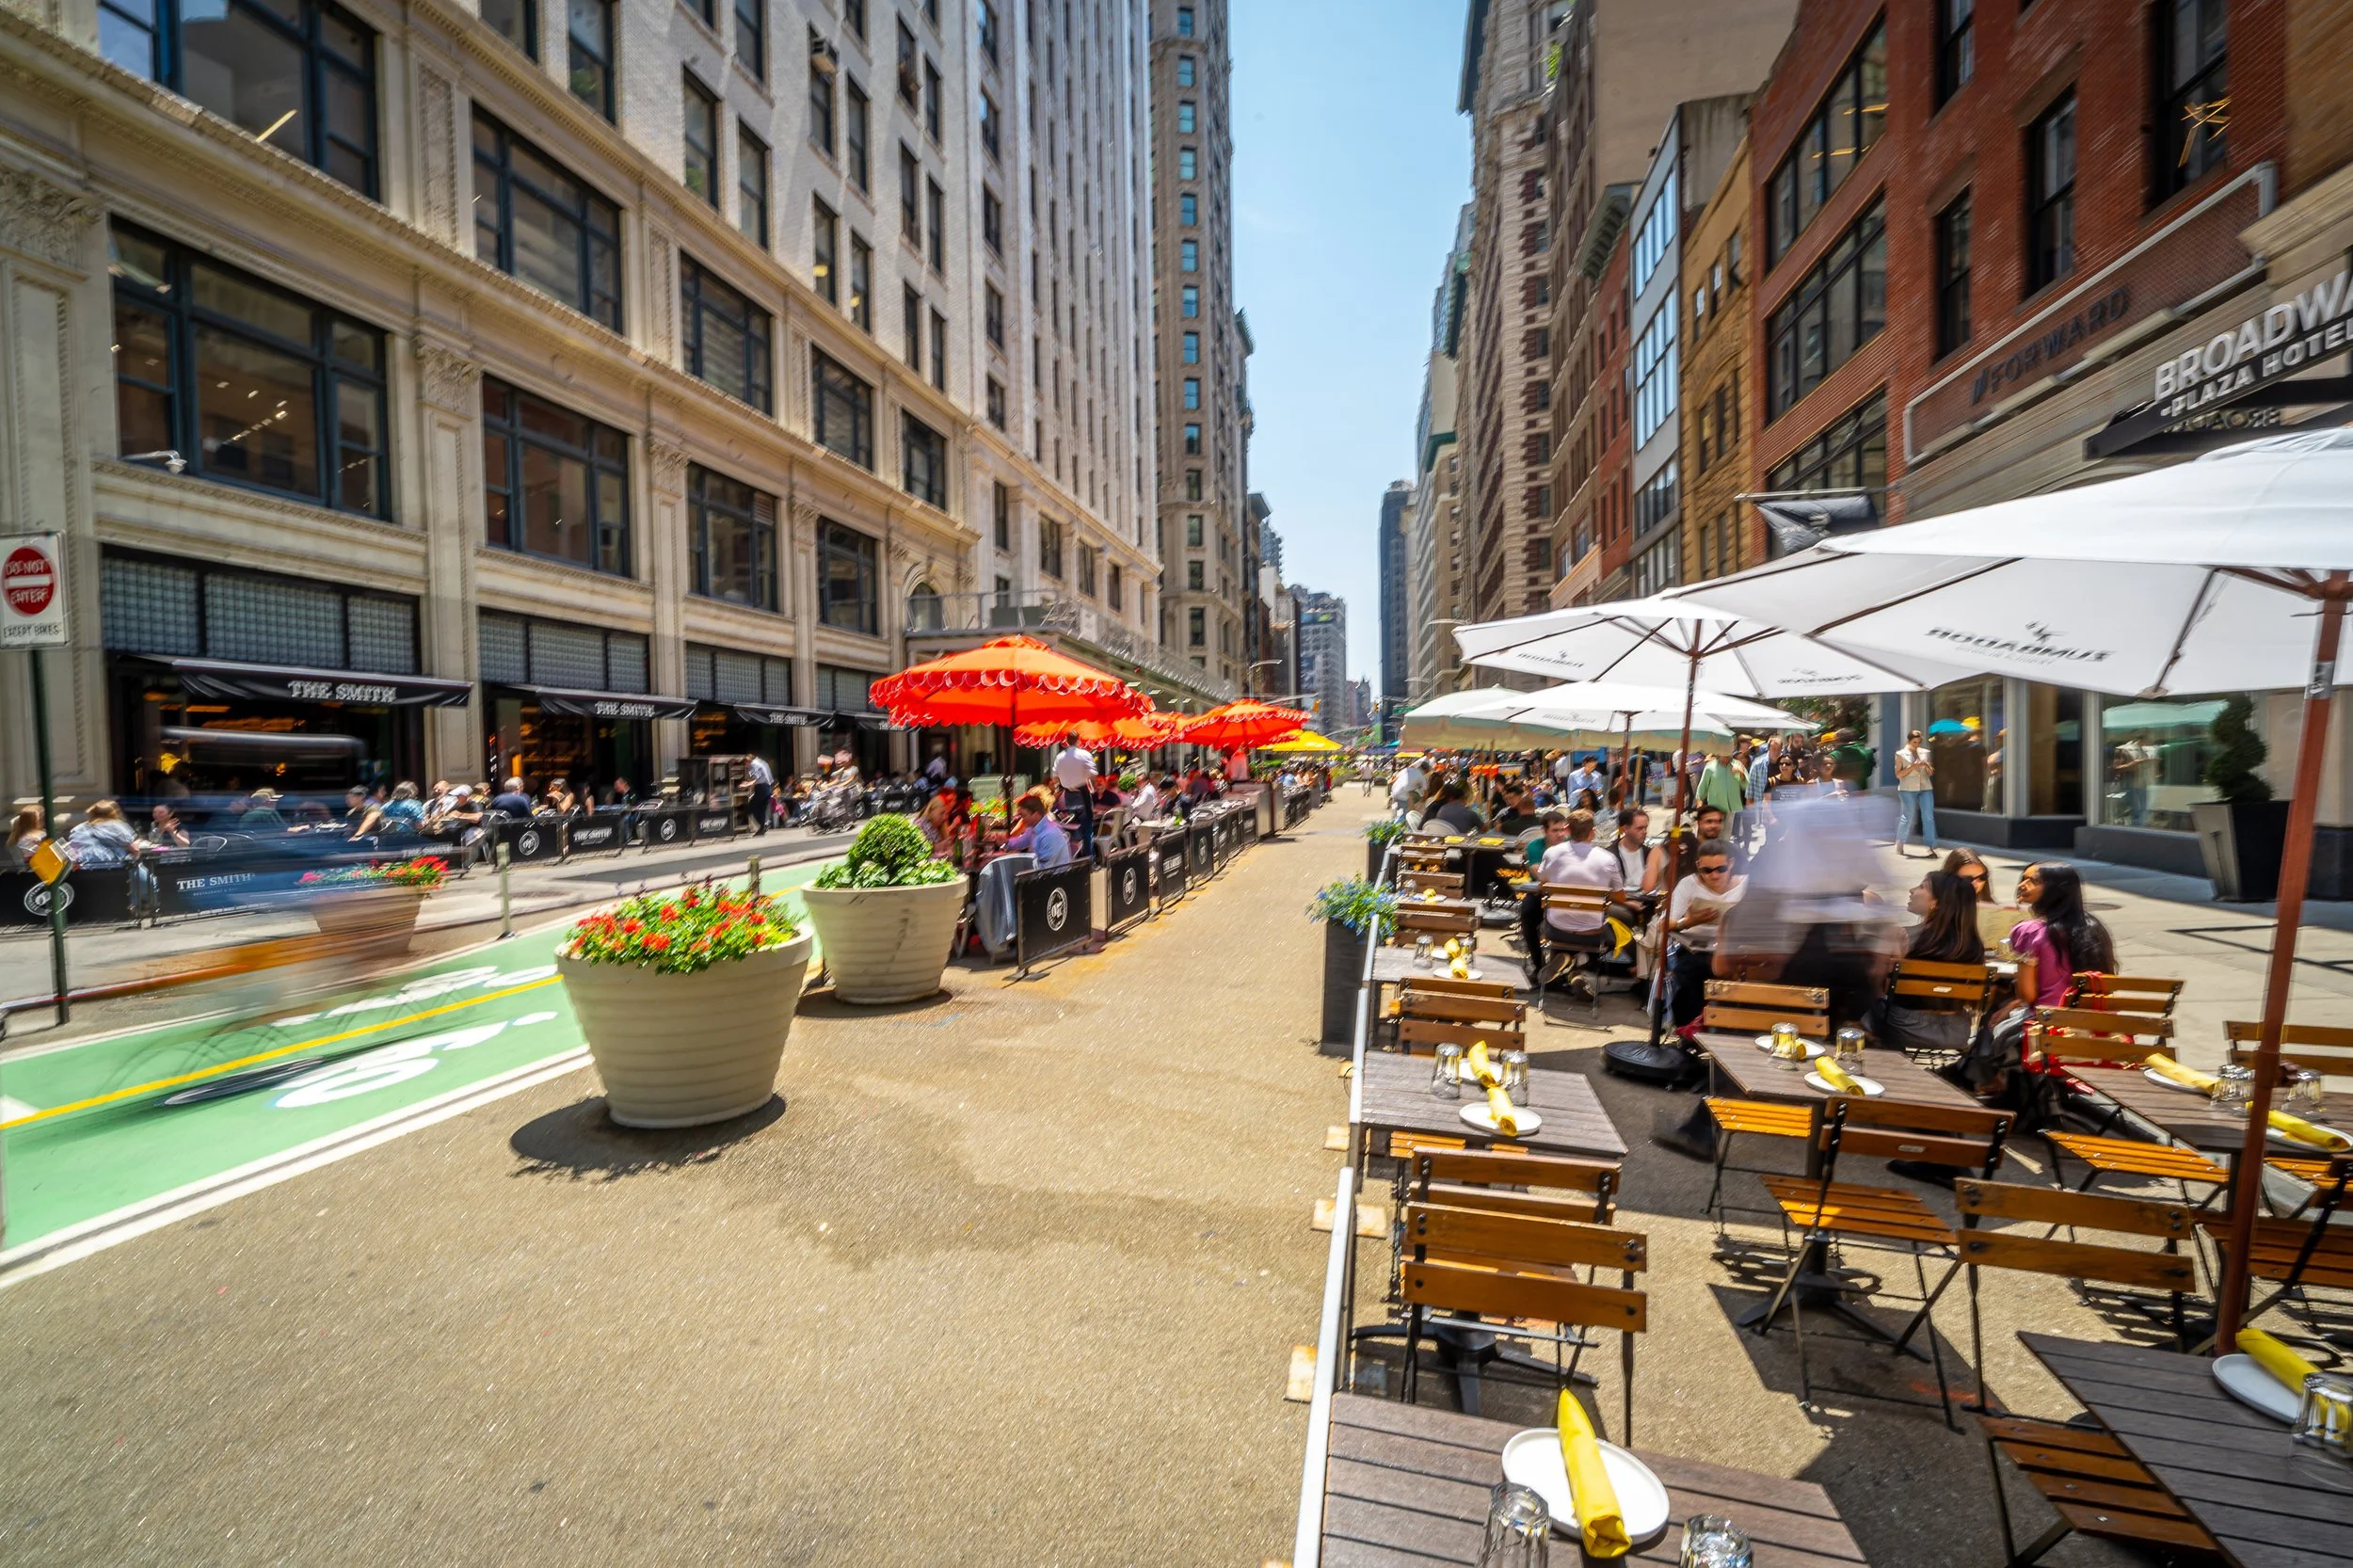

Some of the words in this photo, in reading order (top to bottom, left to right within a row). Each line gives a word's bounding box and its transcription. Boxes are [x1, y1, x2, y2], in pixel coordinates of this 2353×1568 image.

[6, 560, 23, 576] DO
[24, 558, 45, 574] NOT
[10, 588, 48, 604] ENTER
[4, 623, 32, 638] EXCEPT
[34, 621, 60, 636] BIKES
[287, 680, 333, 699] THE
[335, 682, 397, 703] SMITH
[176, 877, 206, 890] THE
[209, 872, 251, 887] SMITH
